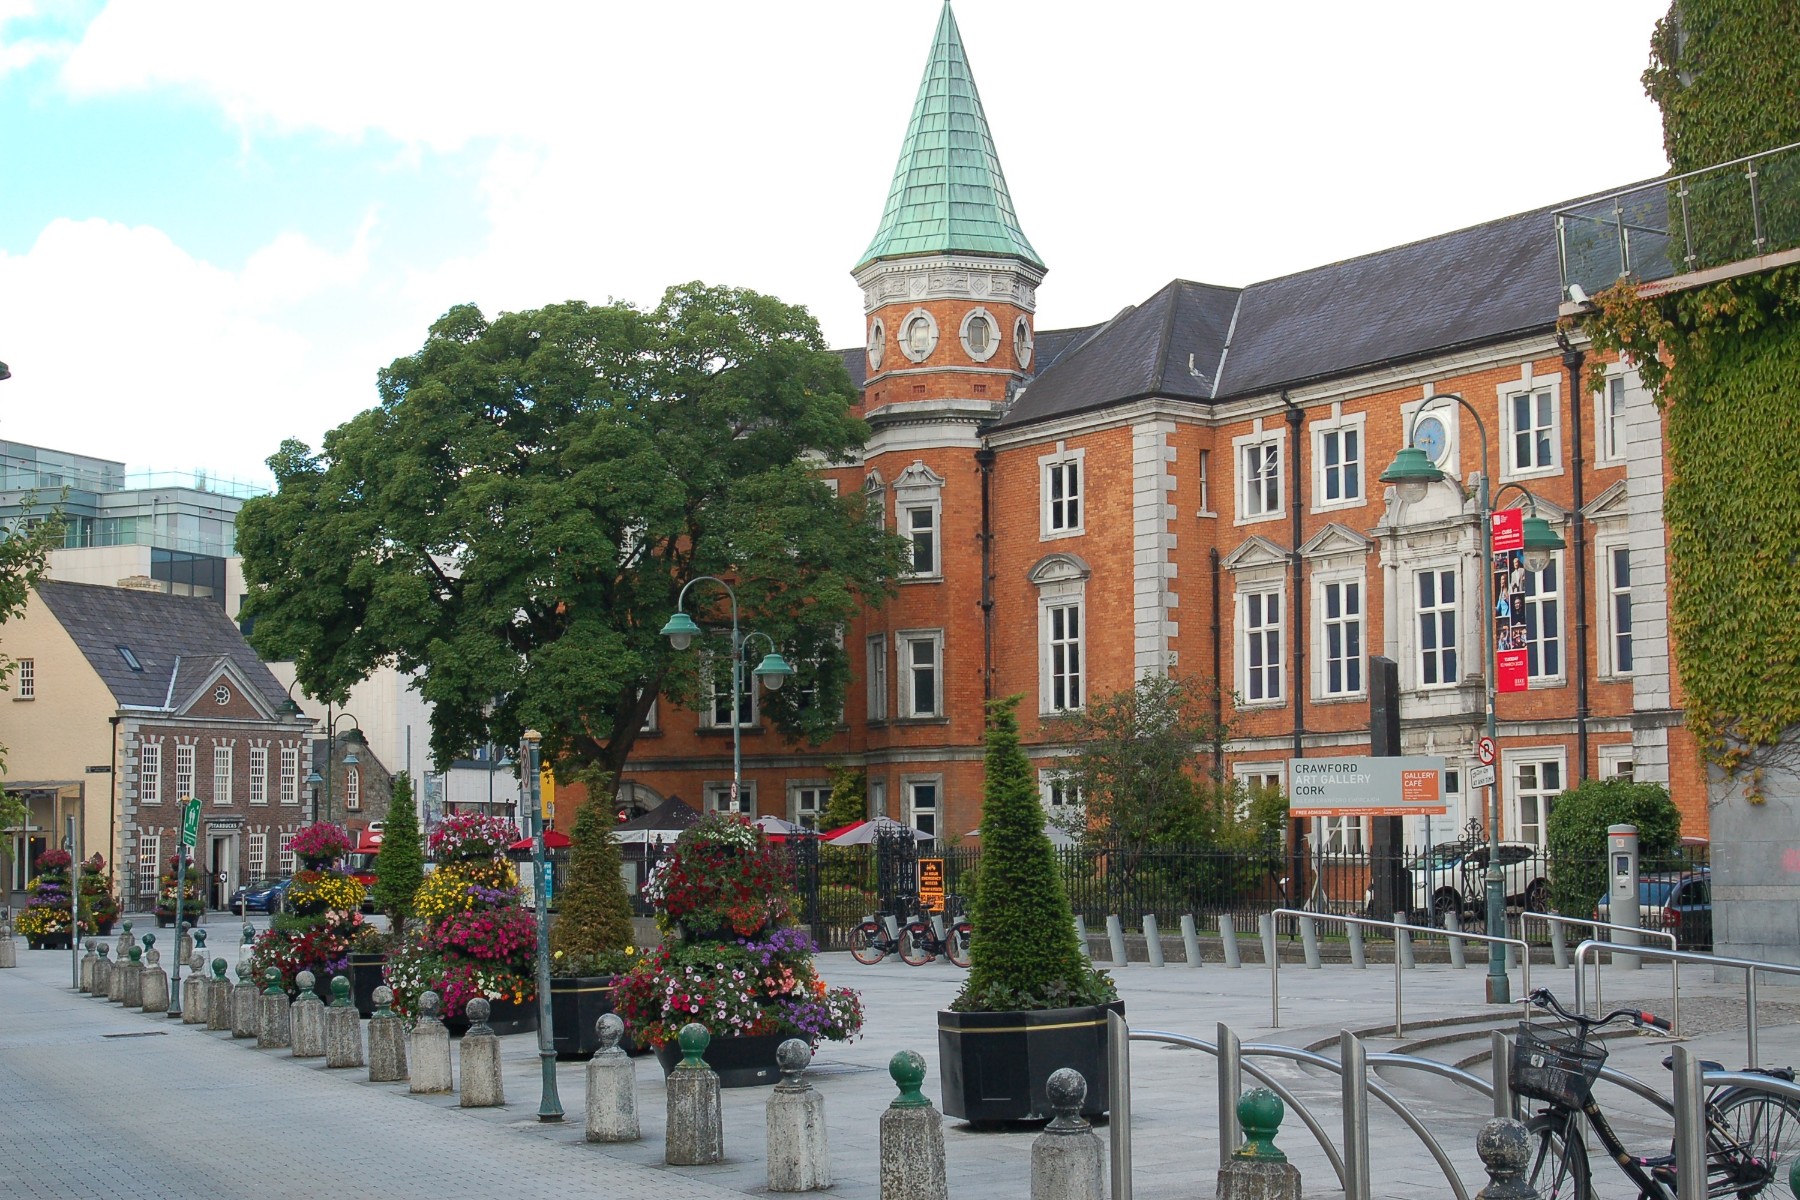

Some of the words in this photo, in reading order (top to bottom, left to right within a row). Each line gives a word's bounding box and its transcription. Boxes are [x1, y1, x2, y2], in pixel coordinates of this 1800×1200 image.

[1295, 763, 1358, 774] CRAWFORD
[1295, 774, 1318, 785] ART
[1320, 773, 1371, 785] GALLERY
[1404, 771, 1435, 779] GALLERY
[1404, 778, 1423, 787] CAFÉ
[1295, 785, 1325, 796] CORK
